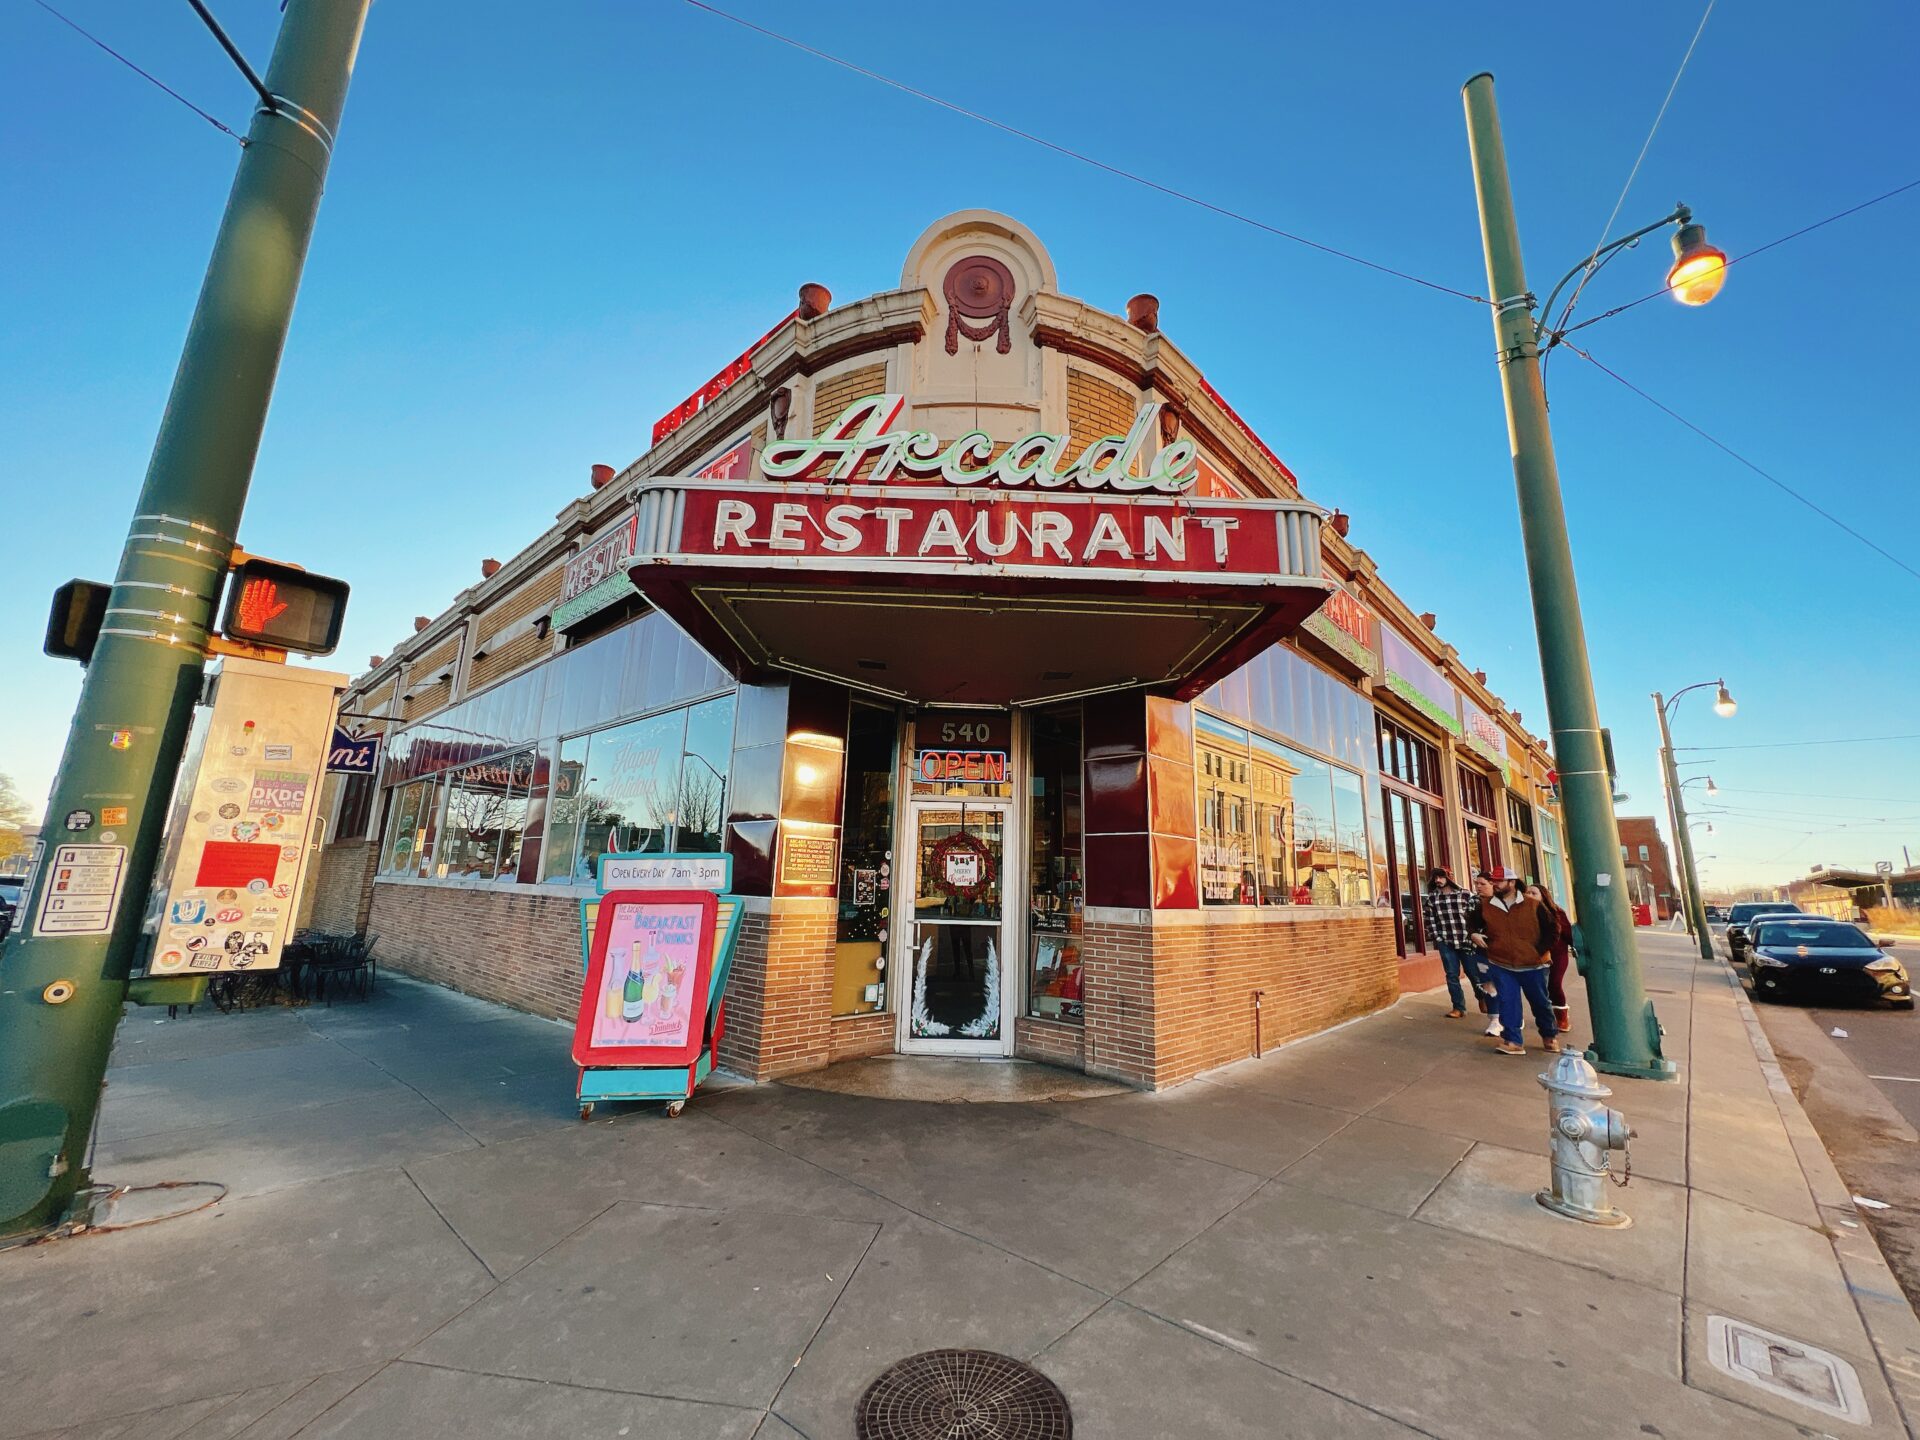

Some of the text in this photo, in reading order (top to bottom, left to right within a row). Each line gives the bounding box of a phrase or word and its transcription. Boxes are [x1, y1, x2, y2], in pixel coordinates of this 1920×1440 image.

[760, 393, 1201, 494] Arcade
[714, 498, 1240, 566] RESTAURANT
[941, 722, 990, 742] 540
[921, 752, 1003, 780] OPEN
[252, 787, 305, 807] DKDC
[612, 868, 630, 878] OPEN
[632, 868, 652, 878] EVERY
[652, 868, 665, 878] DAY
[671, 868, 691, 878] 7am
[699, 868, 720, 880] 3pm
[220, 911, 241, 921] STP
[634, 913, 696, 930] BREAKFAST
[656, 931, 694, 945] DRINKS
